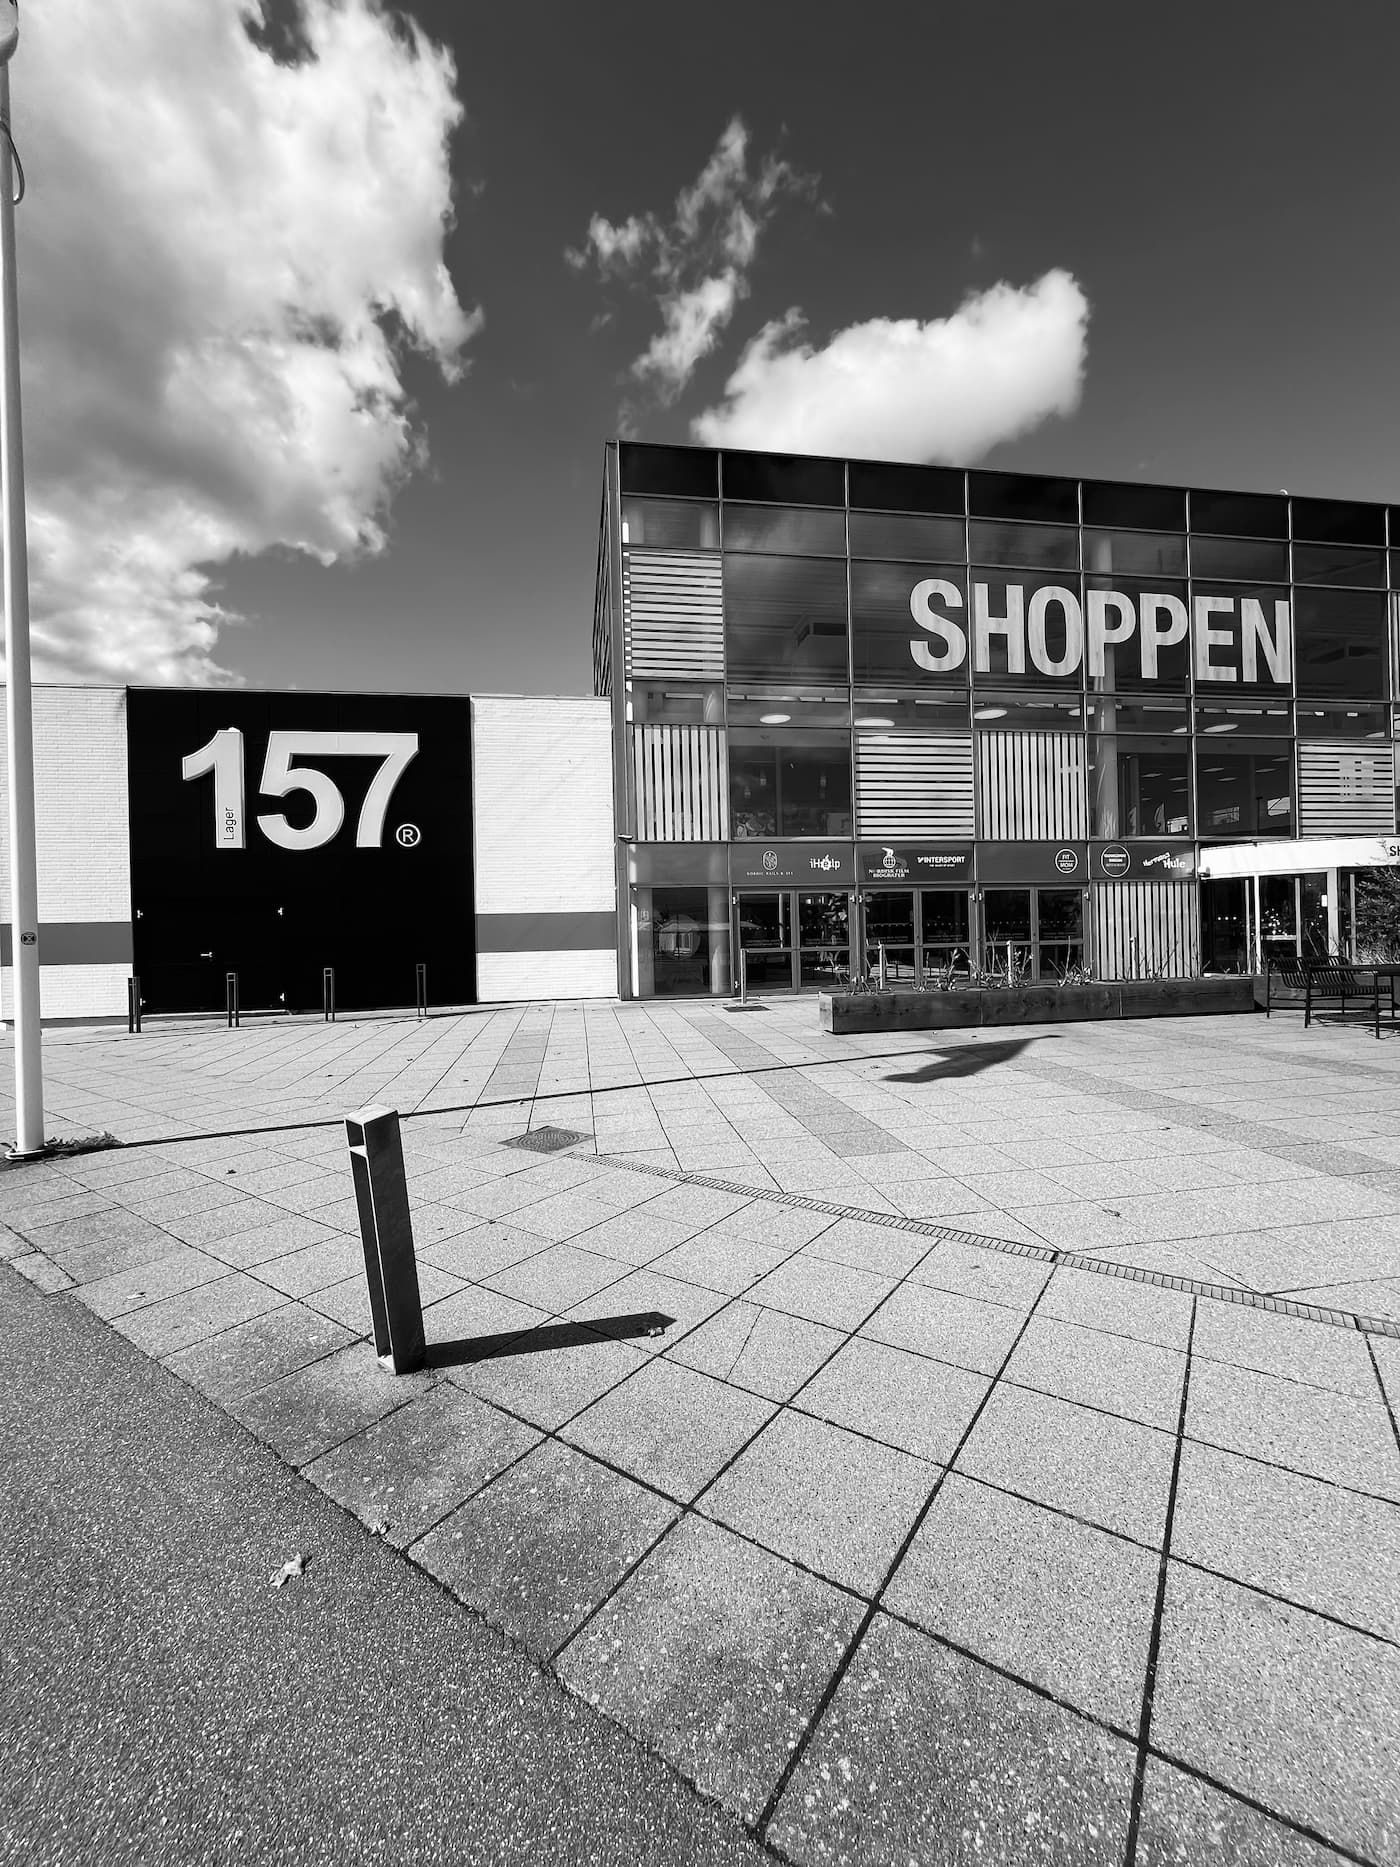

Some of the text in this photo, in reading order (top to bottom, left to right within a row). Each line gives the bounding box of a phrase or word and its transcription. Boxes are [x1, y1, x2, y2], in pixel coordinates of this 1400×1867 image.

[910, 579, 1291, 684] SHOPPEN
[182, 729, 420, 850] 157
[224, 807, 237, 840] Lager
[809, 858, 841, 870] iHelp
[1162, 857, 1186, 869] Hule
